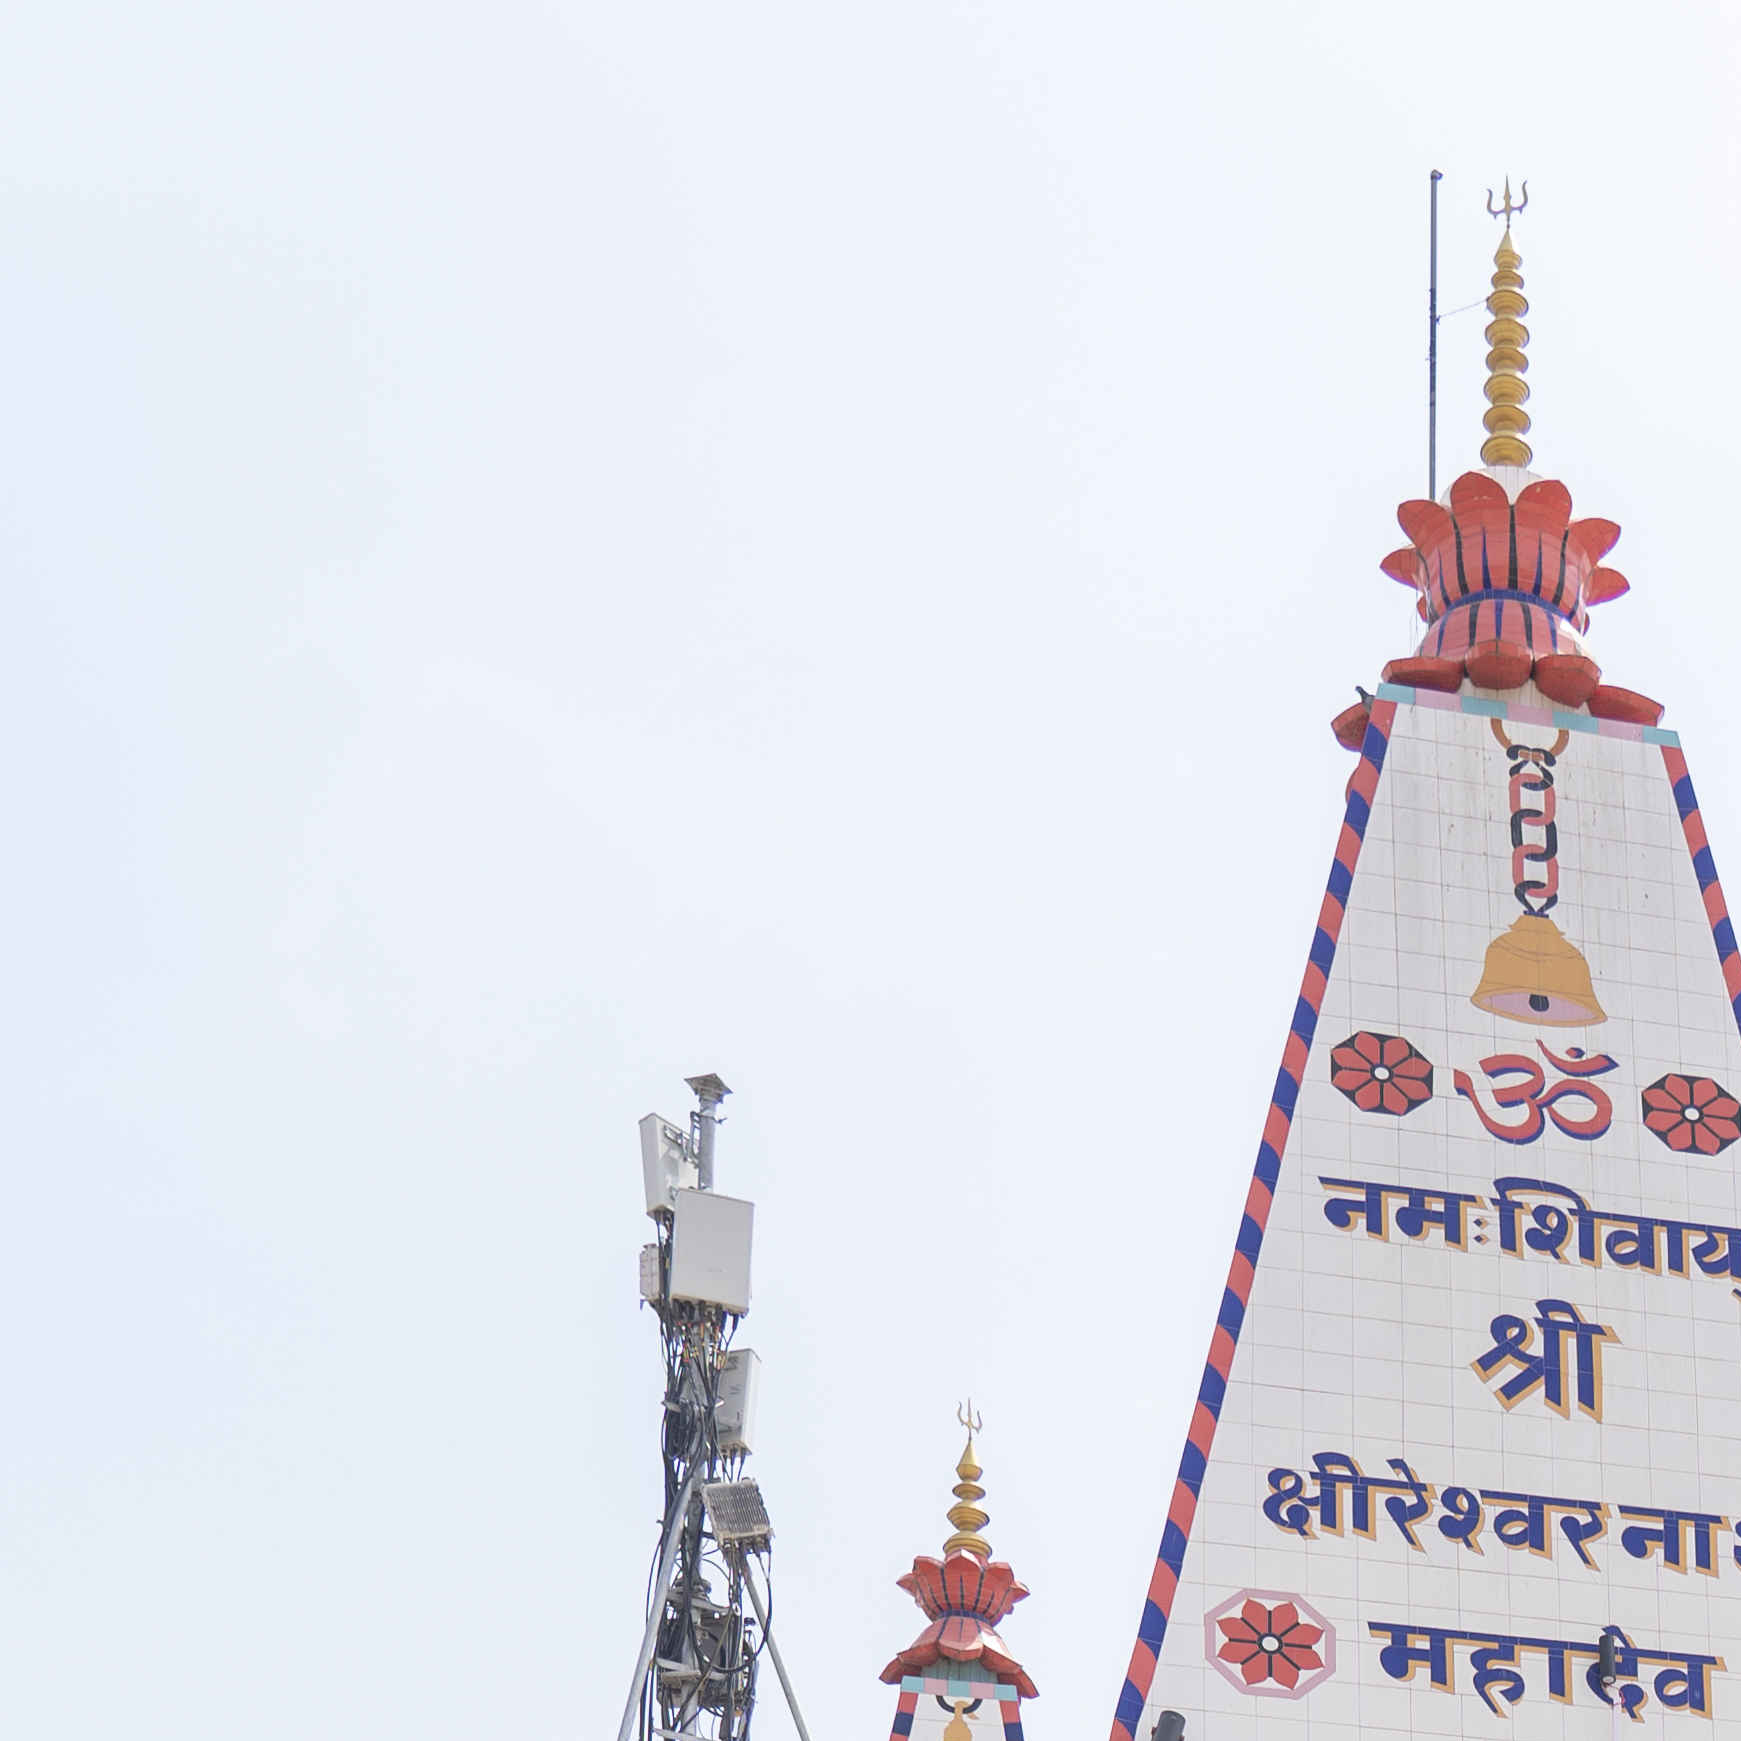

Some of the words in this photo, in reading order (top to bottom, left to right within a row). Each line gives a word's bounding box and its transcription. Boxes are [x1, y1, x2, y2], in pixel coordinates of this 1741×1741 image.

[1454, 1038, 1618, 1144] ॐ
[1470, 1300, 1620, 1422] श्री
[1368, 1622, 1728, 1722] महादेव
